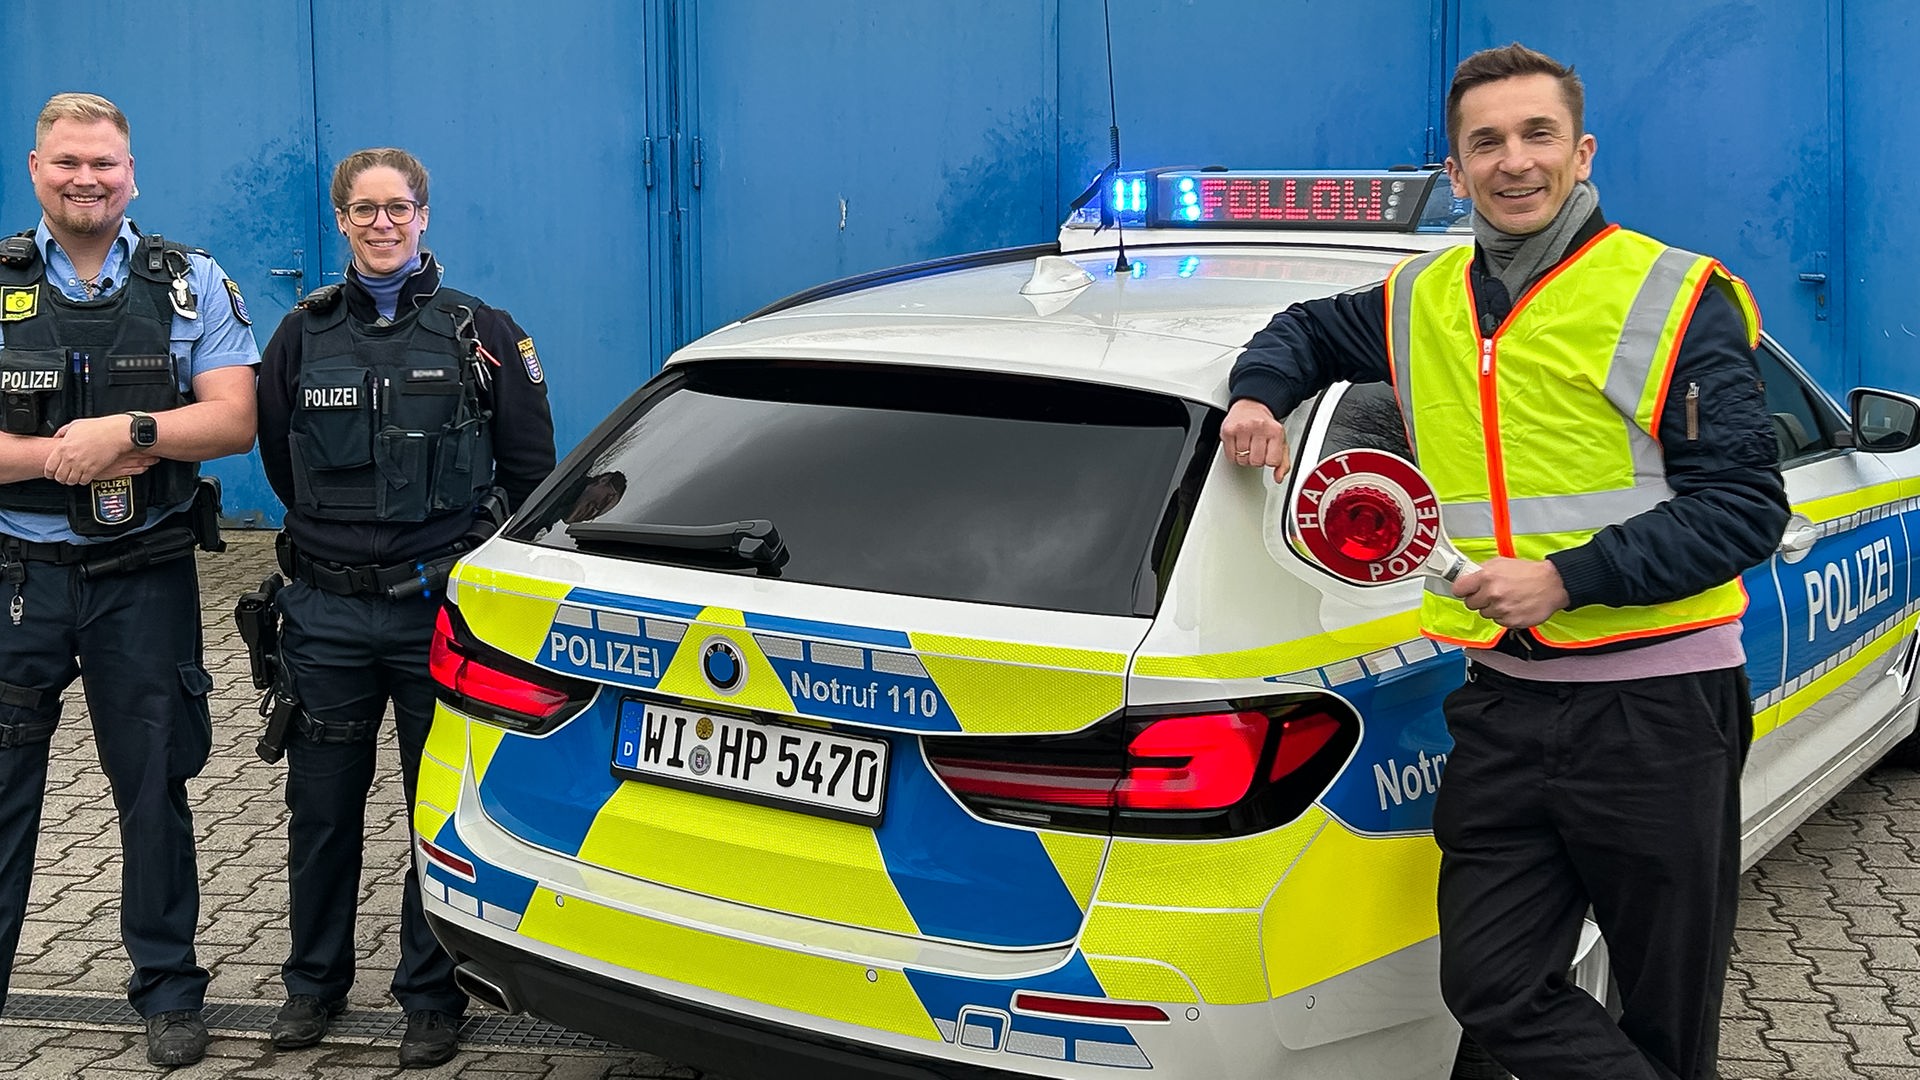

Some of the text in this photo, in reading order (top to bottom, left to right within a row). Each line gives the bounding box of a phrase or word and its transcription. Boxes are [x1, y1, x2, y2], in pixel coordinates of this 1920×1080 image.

[1201, 180, 1382, 220] FOLLOW
[1, 370, 59, 389] POLIZEI
[304, 387, 358, 407] POLIZEI
[93, 478, 131, 489] POLIZEI
[1298, 456, 1351, 529] HALT
[1369, 494, 1438, 582] POLIZEI
[1803, 536, 1894, 642] POLIZEI
[550, 632, 660, 678] POLIZEI
[706, 644, 737, 661] BMW
[791, 671, 938, 718] Notruf 110
[623, 742, 634, 757] D
[643, 712, 878, 802] WI HP 5470
